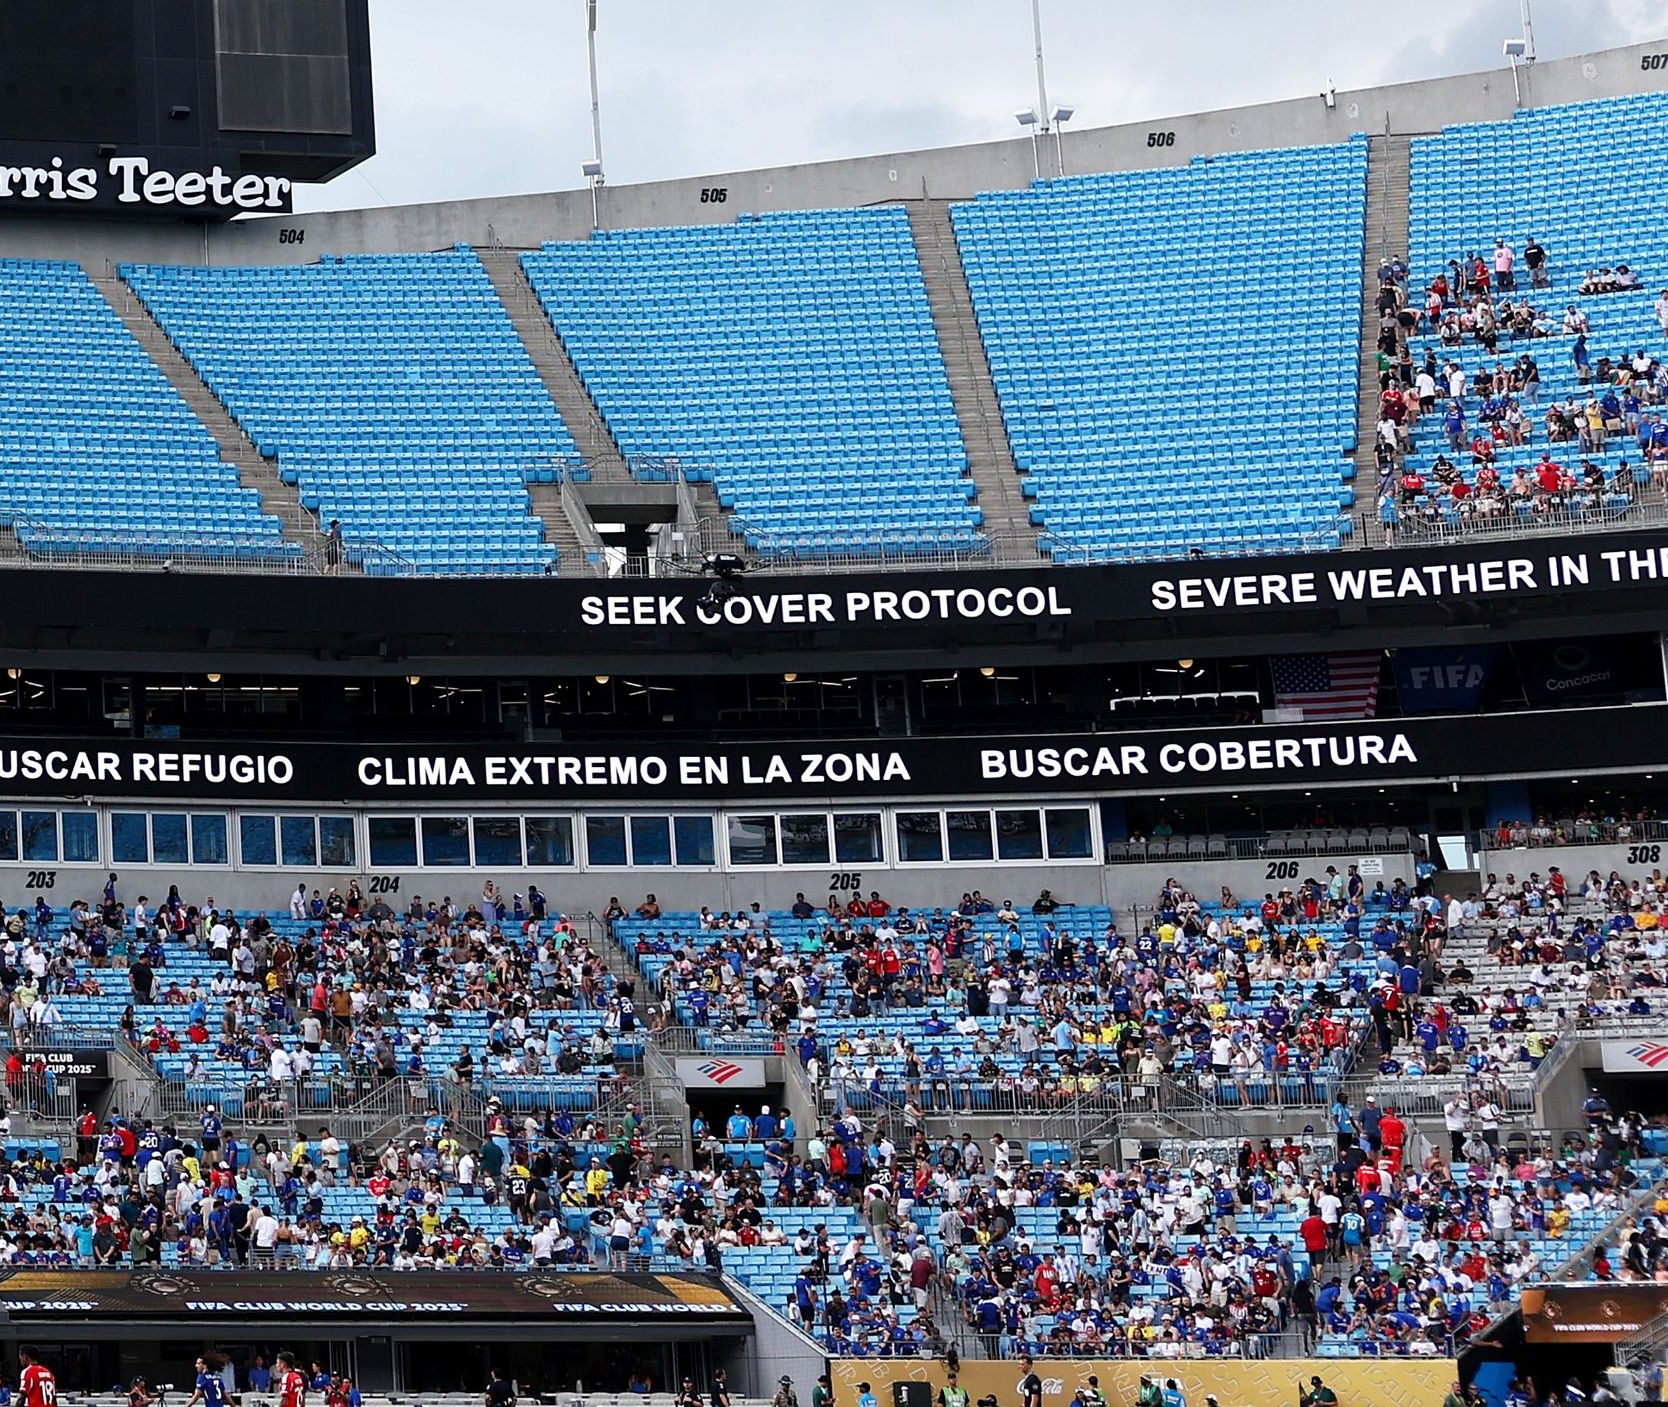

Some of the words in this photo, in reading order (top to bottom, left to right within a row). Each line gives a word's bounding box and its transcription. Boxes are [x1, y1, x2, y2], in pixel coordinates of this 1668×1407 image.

[1640, 54, 1668, 71] 507
[1146, 131, 1176, 148] 506
[108, 156, 291, 208] Teeter
[700, 187, 728, 204] 505
[279, 228, 305, 246] 504
[1151, 572, 1317, 610] SEVERE
[1327, 559, 1538, 601] WEATHER
[1548, 554, 1589, 587] IN
[581, 596, 686, 625] SEEK
[846, 586, 1072, 621] PROTOCOL
[1410, 663, 1486, 690] FIFA
[981, 745, 1149, 779] BUSCAR
[1159, 734, 1418, 773] COBERTURA
[132, 753, 293, 784] REFUGIO
[358, 757, 476, 786] CLIMA
[485, 756, 667, 785] EXTREMO
[679, 756, 729, 785] EN
[741, 755, 793, 784] LA
[800, 752, 911, 783] ZONA
[1626, 844, 1662, 864] 308
[25, 870, 57, 889] 203
[1265, 861, 1300, 880] 206
[369, 875, 400, 894] 204
[829, 872, 862, 891] 205
[48, 1053, 74, 1063] CLUB
[511, 1178, 526, 1195] 23
[185, 1302, 233, 1311] FIFA
[234, 1302, 286, 1311] CLUB
[287, 1302, 363, 1311] WORLD
[365, 1302, 408, 1311] CUP
[553, 1303, 600, 1313] FIFA
[601, 1303, 653, 1313] CLUB
[653, 1303, 728, 1313] WORLD
[213, 1379, 221, 1399] 3
